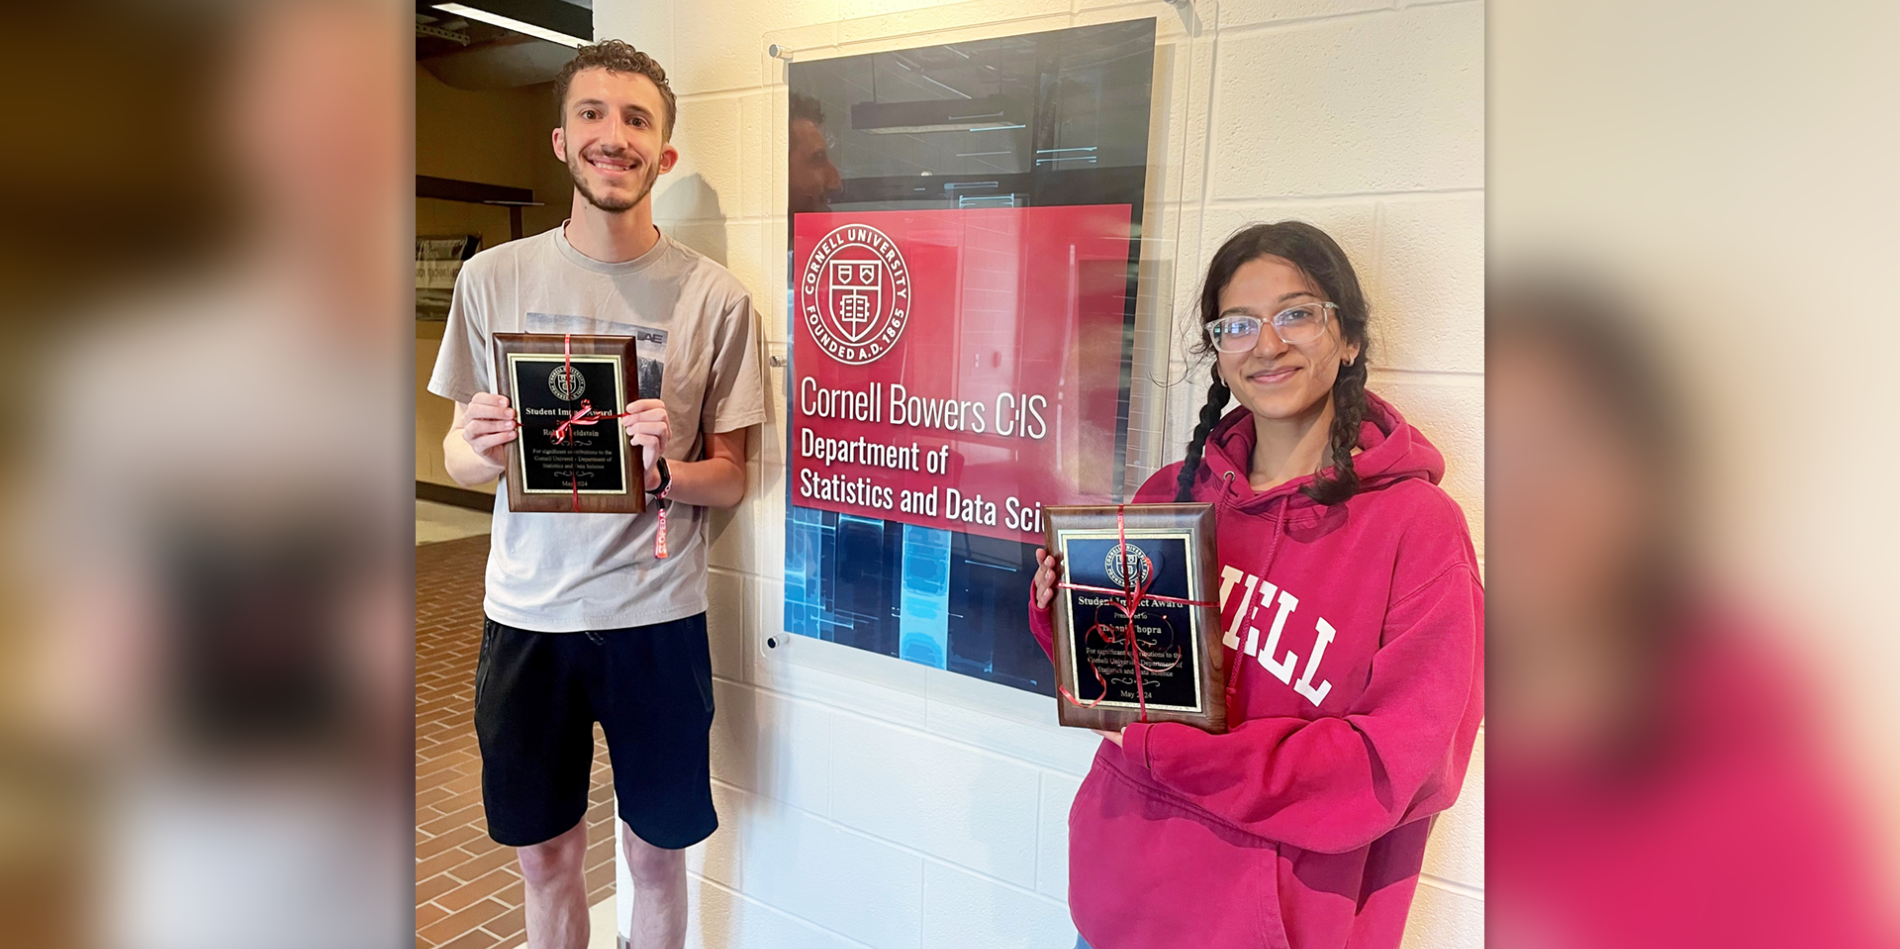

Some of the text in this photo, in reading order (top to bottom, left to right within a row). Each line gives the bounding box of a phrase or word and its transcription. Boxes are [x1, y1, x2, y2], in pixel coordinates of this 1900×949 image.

[805, 229, 907, 299] CORNELL UNIVERSITY
[806, 305, 904, 360] FOUNDED A.D. 1865
[525, 407, 556, 416] Student
[800, 376, 881, 423] Cornell
[889, 383, 986, 433] Bowers
[801, 428, 949, 474] Department of
[800, 468, 1045, 533] Statistics and Data Sci
[1134, 624, 1162, 636] hopra
[1120, 690, 1134, 698] May
